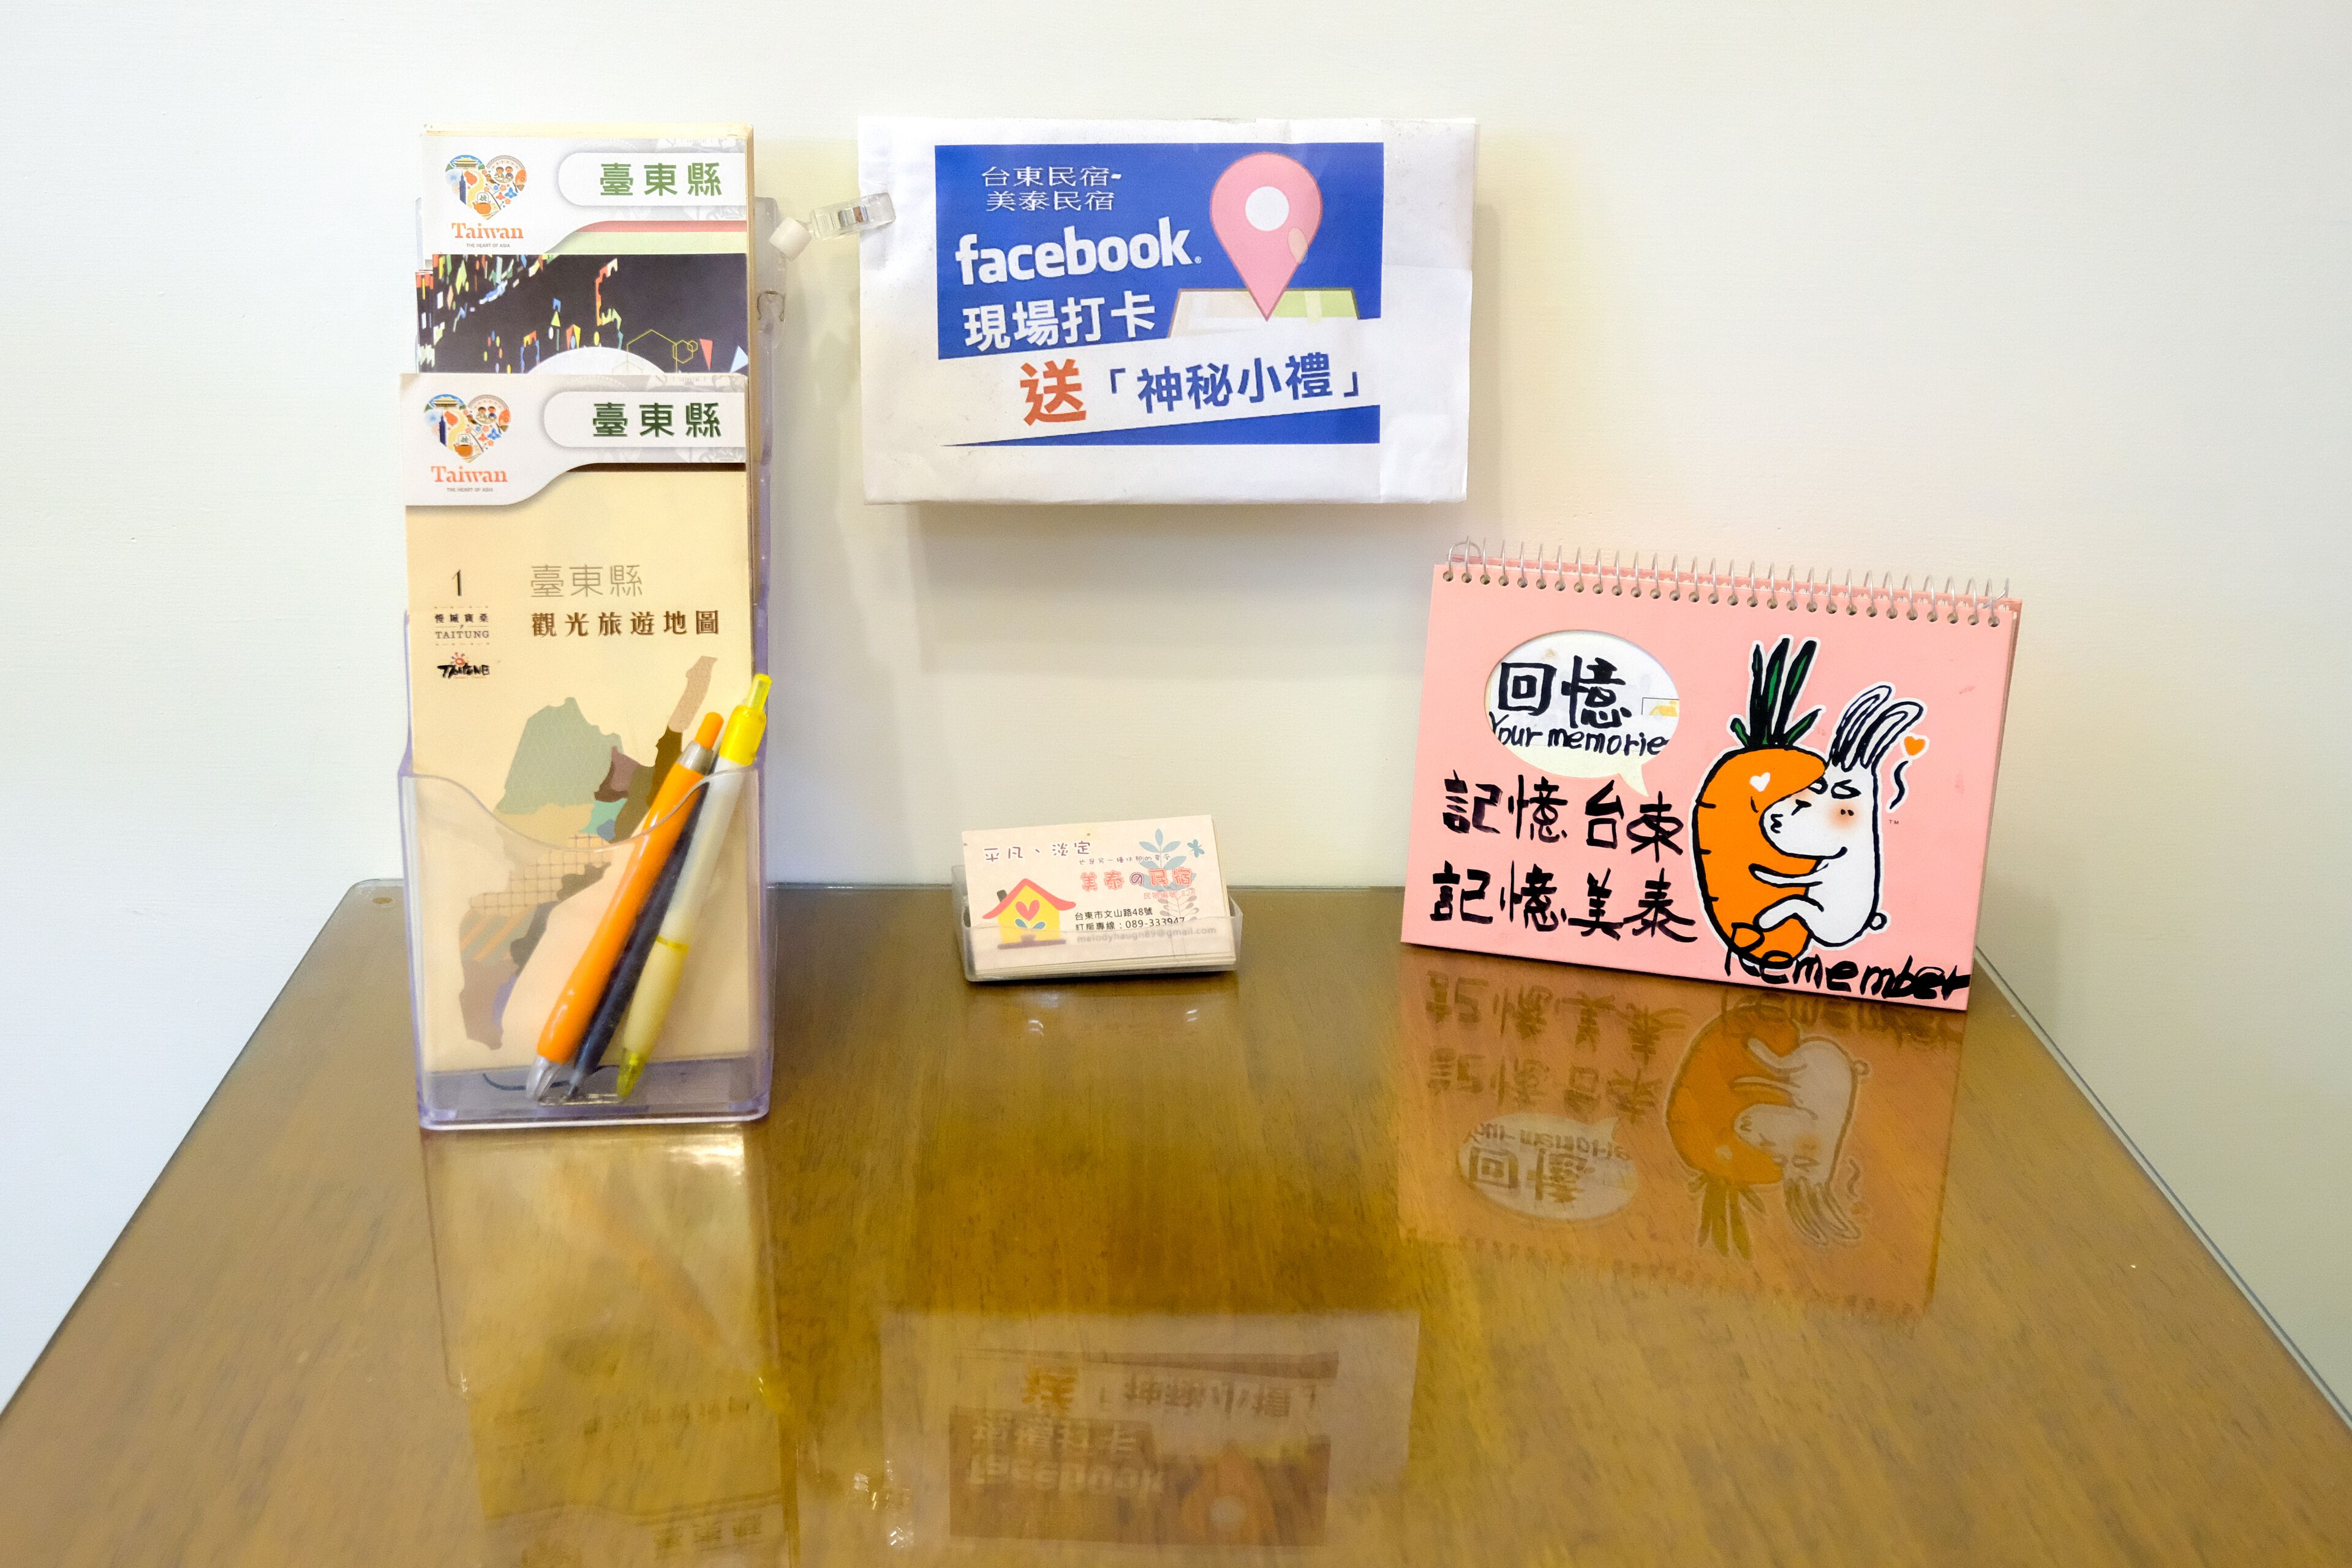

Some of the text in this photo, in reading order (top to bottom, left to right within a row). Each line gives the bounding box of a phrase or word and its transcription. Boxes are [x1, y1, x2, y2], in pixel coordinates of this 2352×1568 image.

[599, 162, 722, 197] 臺東縣
[985, 190, 1115, 212] 美泰民宿
[451, 222, 524, 239] Taiwan
[955, 216, 1193, 285] facebook
[963, 291, 1156, 351] 現場打卡
[1019, 358, 1088, 426] 送
[592, 402, 722, 439] 臺東縣
[430, 465, 508, 483] Taiwan
[451, 569, 462, 597] 1
[530, 564, 644, 598] 臺東縣
[435, 631, 490, 639] TAITUNG
[532, 609, 720, 638] 觀光旅遊地圖
[1498, 655, 1633, 729] 回憶
[1488, 711, 1544, 748] Your
[1442, 769, 1684, 862] 記憶台東
[1080, 867, 1193, 892] 美泰の民宿
[1075, 907, 1153, 921] 台東市文山路48號
[1430, 861, 1698, 943] 記憶美泰
